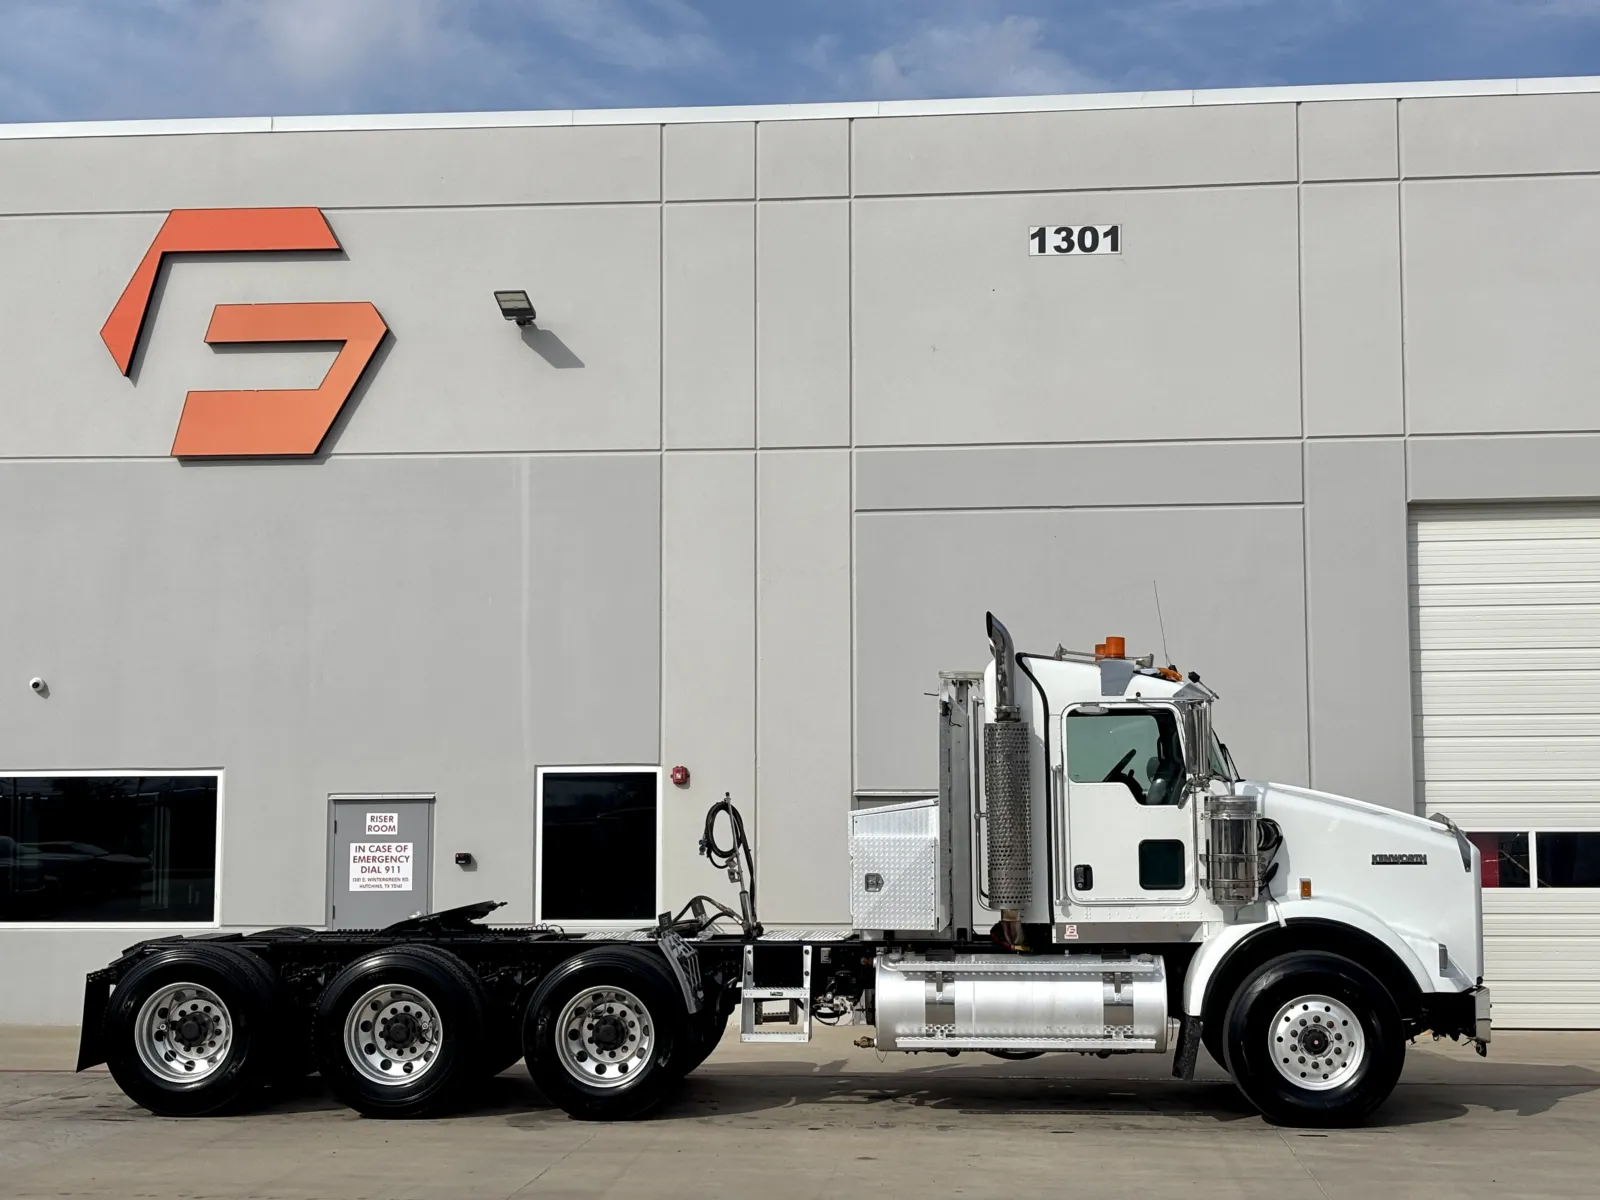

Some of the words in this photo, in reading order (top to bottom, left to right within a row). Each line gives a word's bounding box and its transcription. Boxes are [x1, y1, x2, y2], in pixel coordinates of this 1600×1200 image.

[1030, 225, 1119, 254] 1301
[370, 815, 394, 823] RISER
[367, 824, 396, 832] ROOM
[355, 845, 365, 853] IN
[368, 845, 392, 853] CASE
[395, 845, 409, 853] OF
[352, 855, 410, 864] EMERGENCY
[1371, 854, 1427, 865] KENWORTH
[360, 866, 382, 874] DIAL
[385, 865, 401, 874] 911
